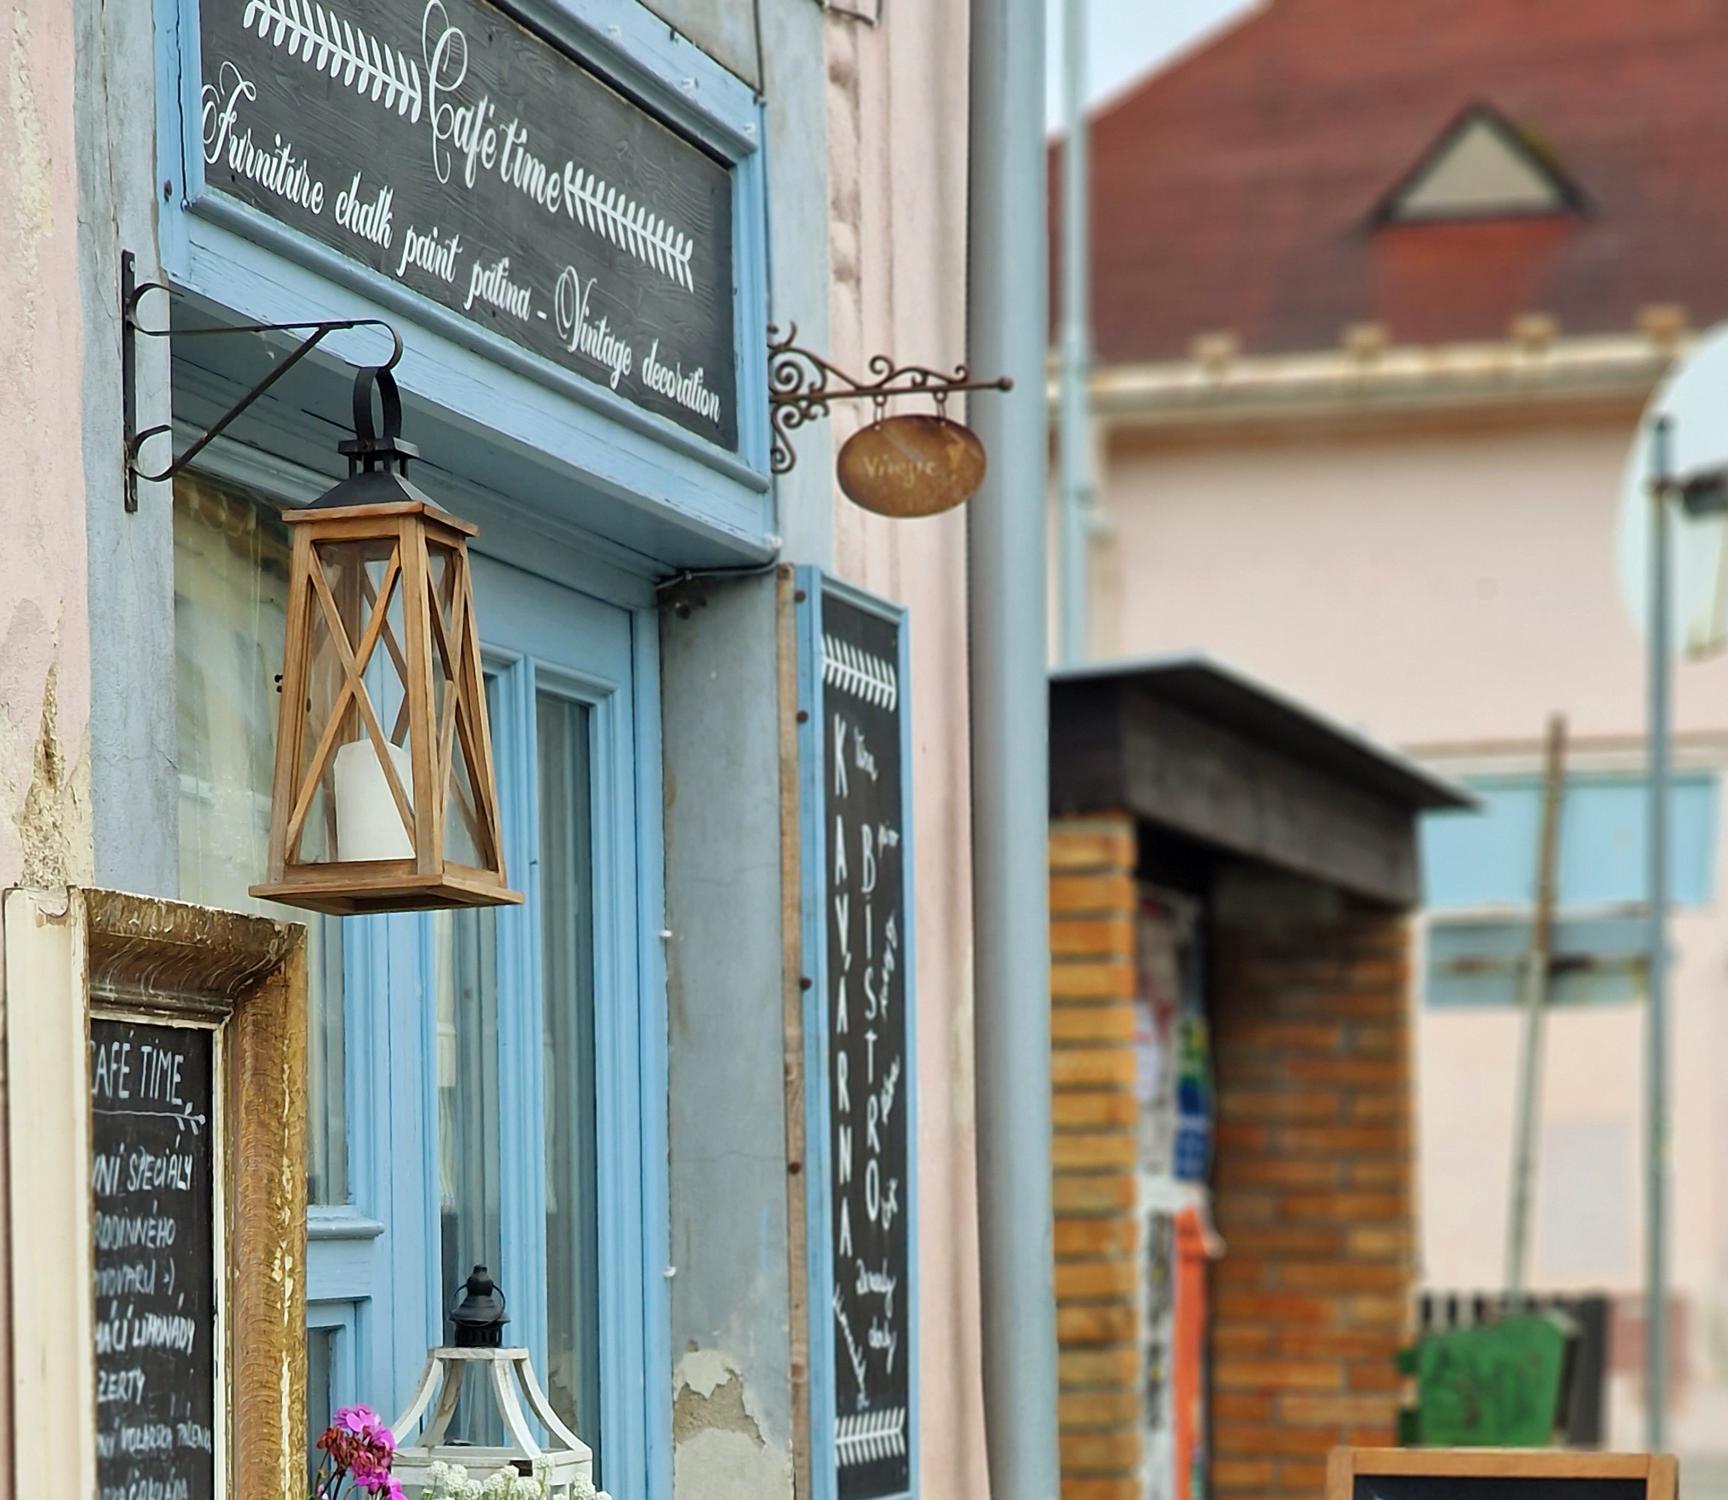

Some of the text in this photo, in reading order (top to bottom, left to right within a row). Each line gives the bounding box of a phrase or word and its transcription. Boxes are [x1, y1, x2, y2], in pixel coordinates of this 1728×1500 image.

[202, 61, 324, 215] Furniture
[334, 171, 394, 249] chalk
[396, 224, 462, 283] paint
[464, 257, 532, 322] patina
[554, 265, 632, 390] Vintage
[642, 338, 722, 423] decoration
[91, 1029, 134, 1099] AFÉ
